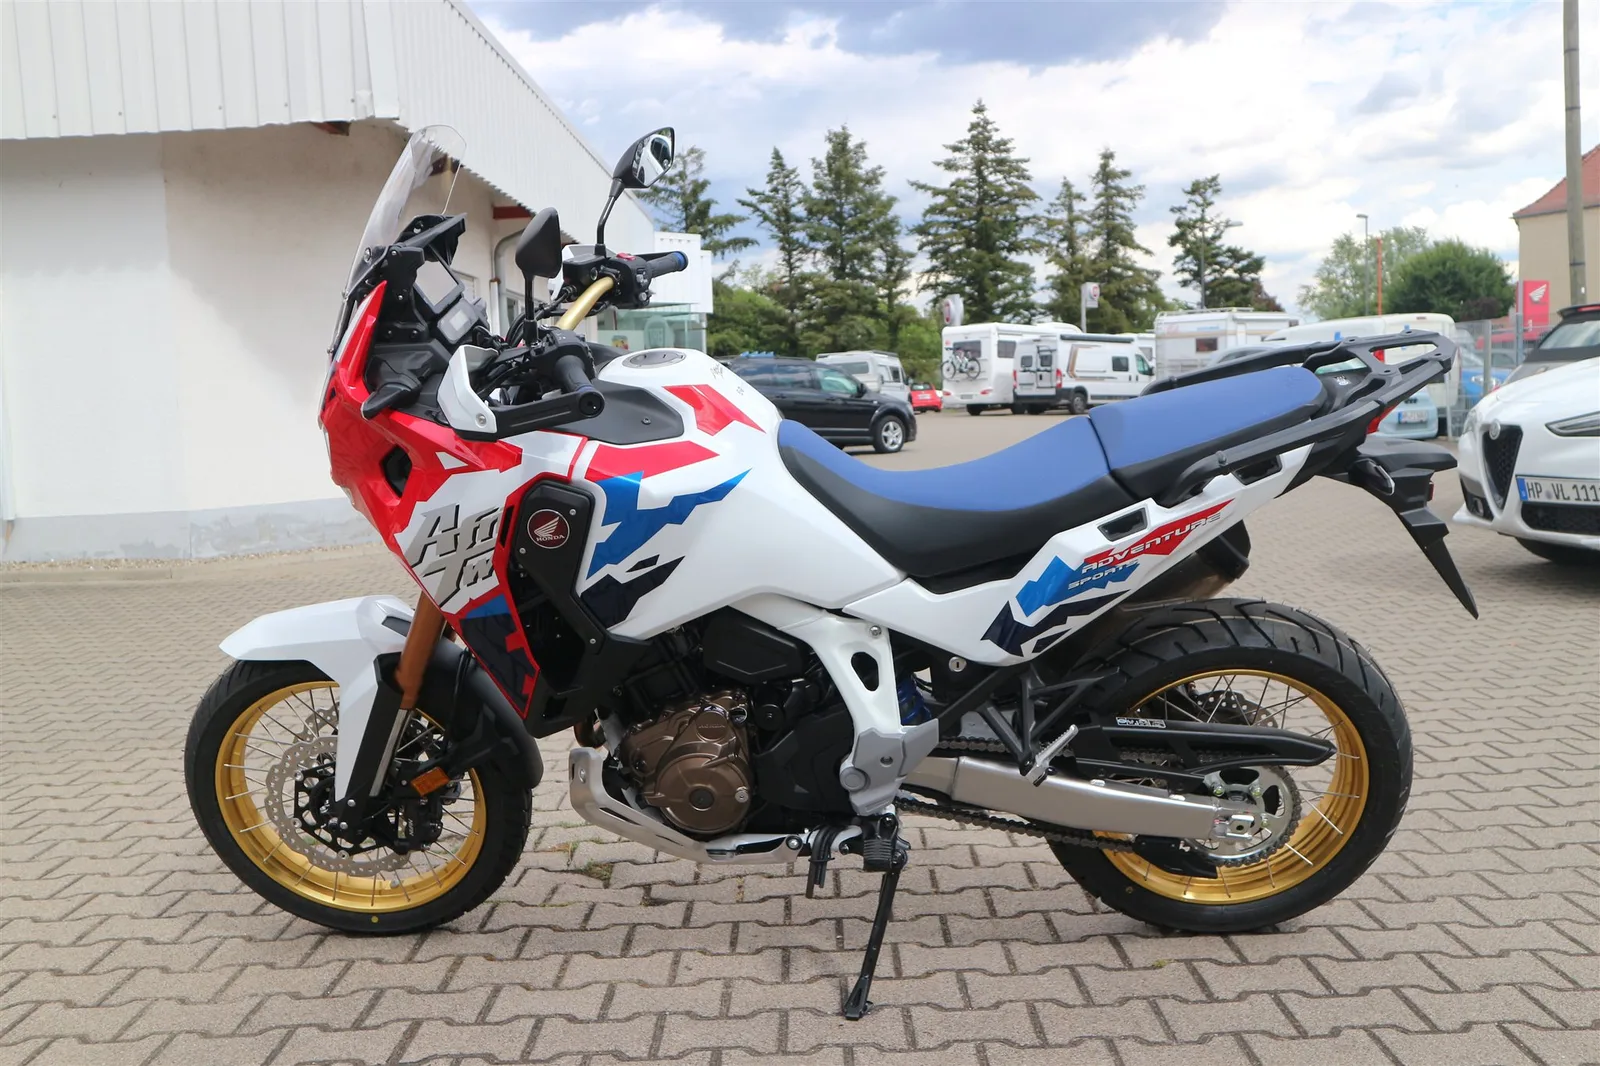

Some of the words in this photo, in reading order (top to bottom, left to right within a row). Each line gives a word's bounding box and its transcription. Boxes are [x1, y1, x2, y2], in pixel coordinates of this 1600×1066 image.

[1526, 481, 1543, 499] HP
[1551, 482, 1570, 501] VL
[1572, 484, 1600, 502] 111
[536, 534, 565, 542] HONDA
[1081, 512, 1221, 575] ADVENTURE
[1068, 559, 1138, 590] SPORTS
